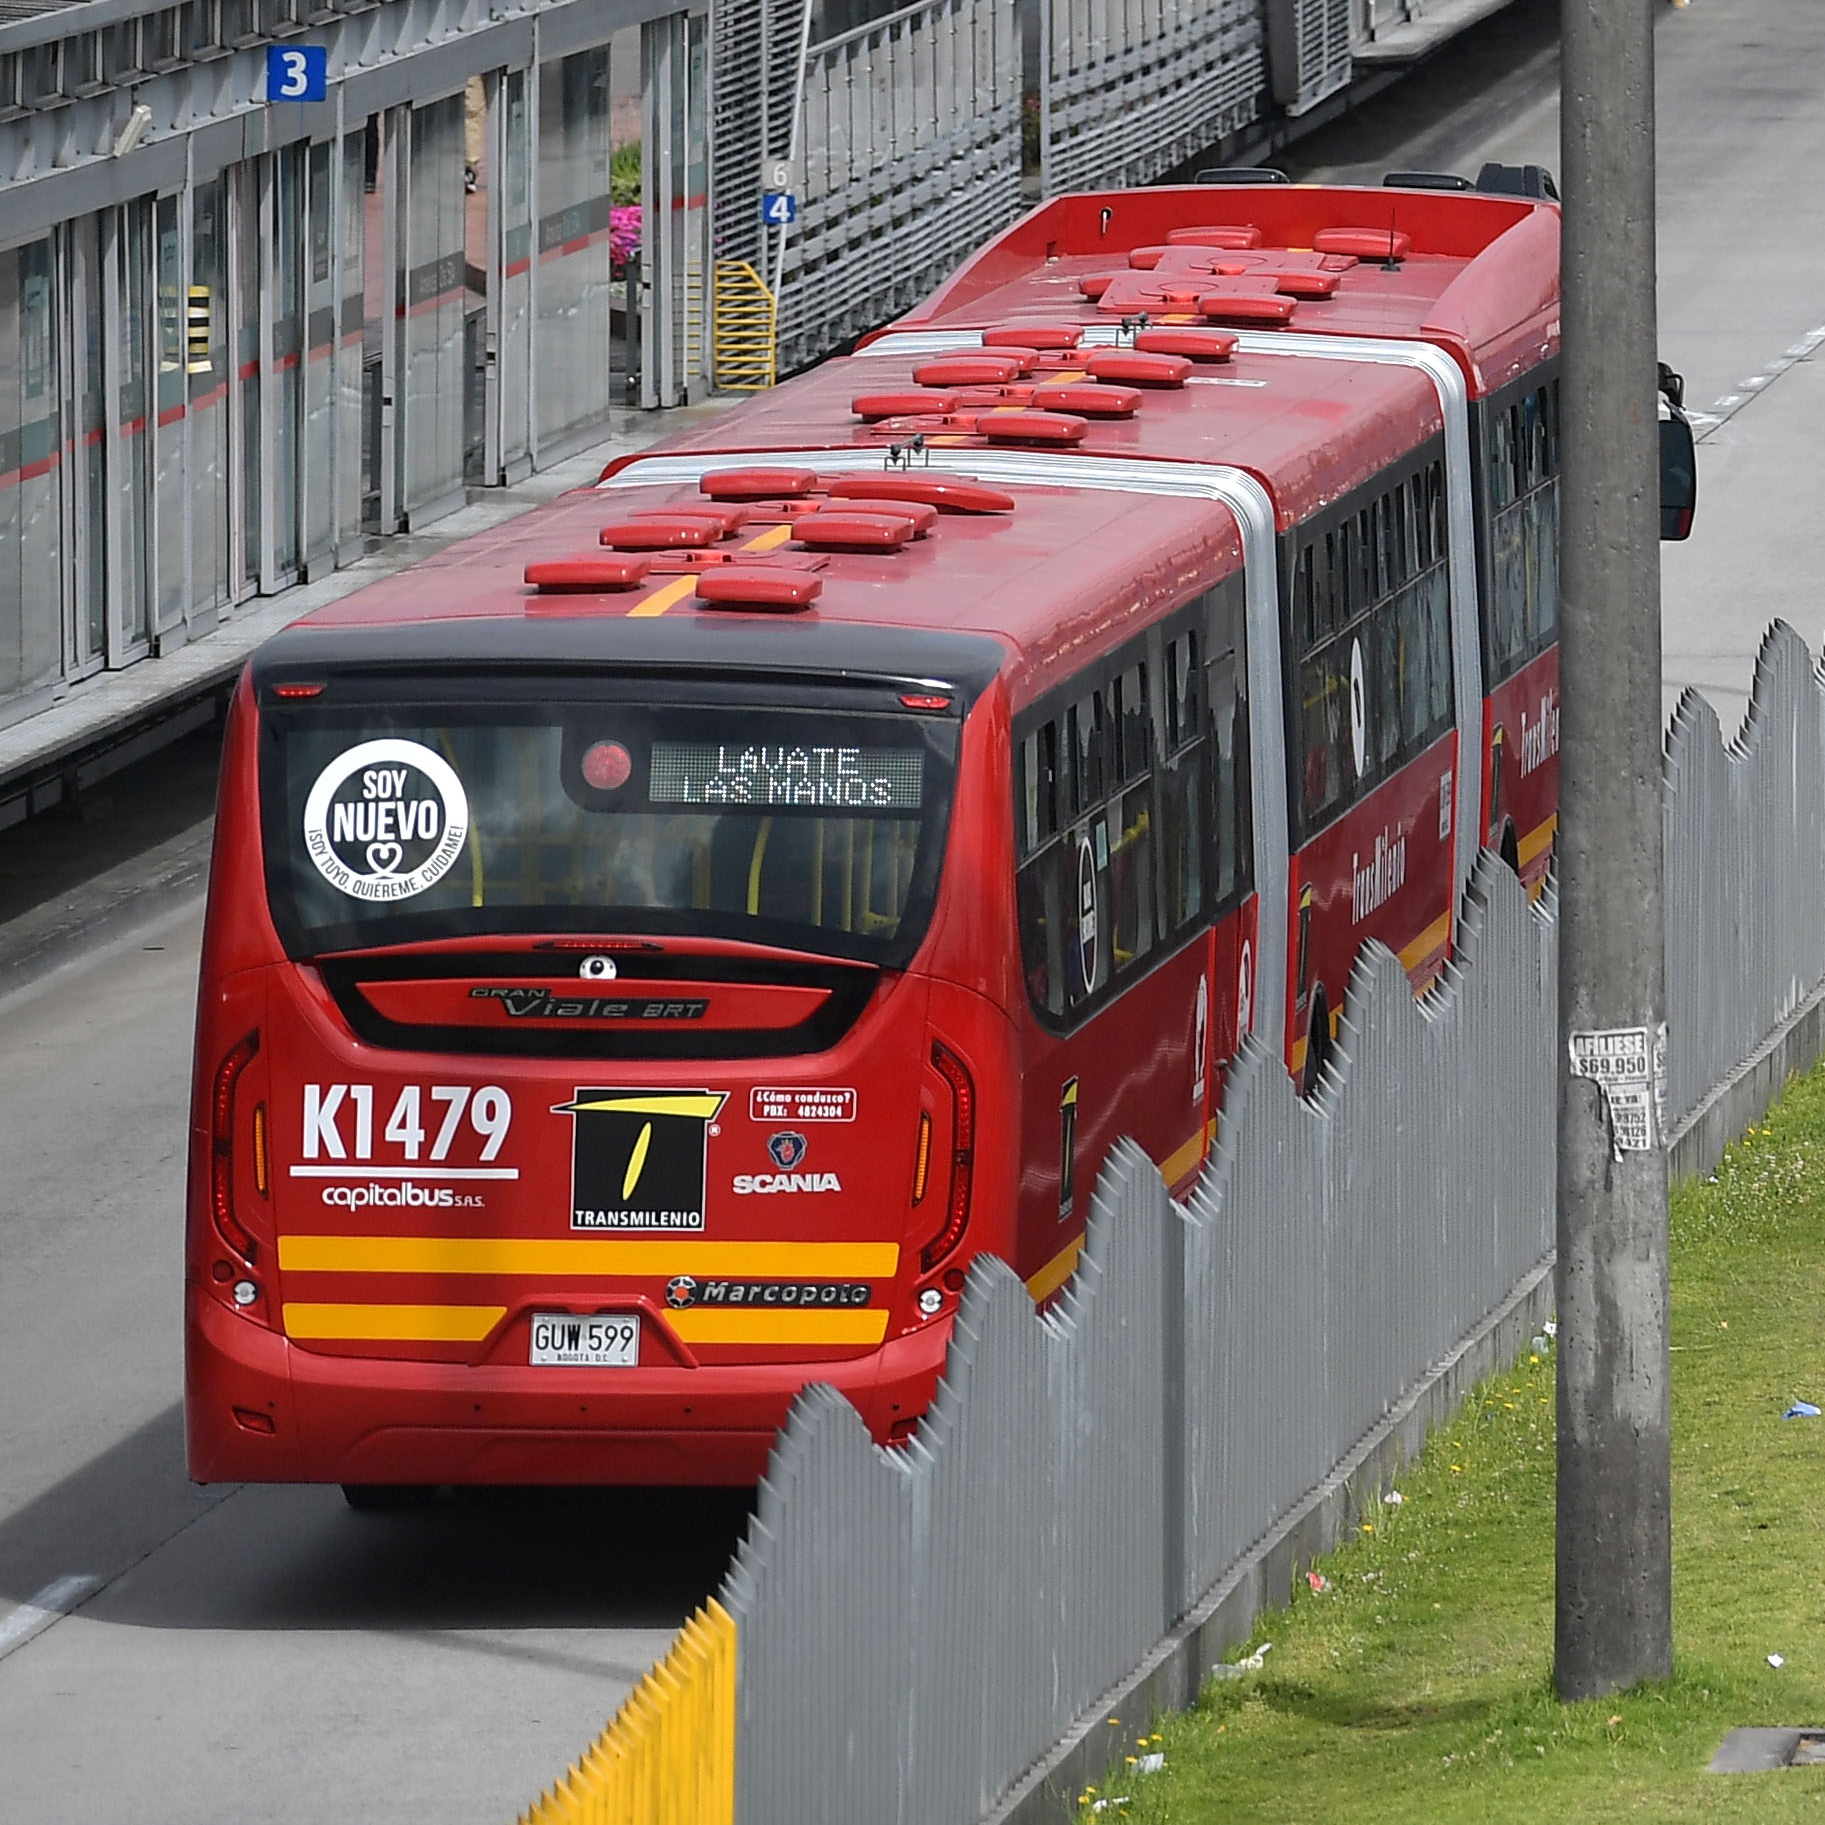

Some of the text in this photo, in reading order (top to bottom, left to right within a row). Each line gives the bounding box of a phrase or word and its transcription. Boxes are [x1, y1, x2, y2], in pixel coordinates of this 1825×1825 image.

[279, 50, 308, 97] 3
[773, 163, 788, 186] 6
[769, 196, 791, 223] 4
[718, 745, 861, 775] LAVATE
[362, 769, 408, 799] SOY
[682, 775, 893, 806] LAS MANOS
[333, 799, 439, 843] NUEVO
[1352, 821, 1405, 926] TransMilenio
[470, 987, 548, 998] GRAN
[502, 998, 708, 1018] Viale BRT
[1575, 1034, 1644, 1056] AFILIESE
[1579, 1055, 1646, 1075] $69.950
[756, 1091, 792, 1103] ¿Cómo
[301, 1083, 512, 1162] K1479
[763, 1104, 843, 1118] PBX: 4824304
[732, 1172, 842, 1194] SCANIA
[322, 1181, 454, 1212] capitalbus
[575, 1209, 701, 1227] TRANSMILENIO
[702, 1280, 869, 1306] Marcopolo
[534, 1324, 635, 1353] GUW 599
